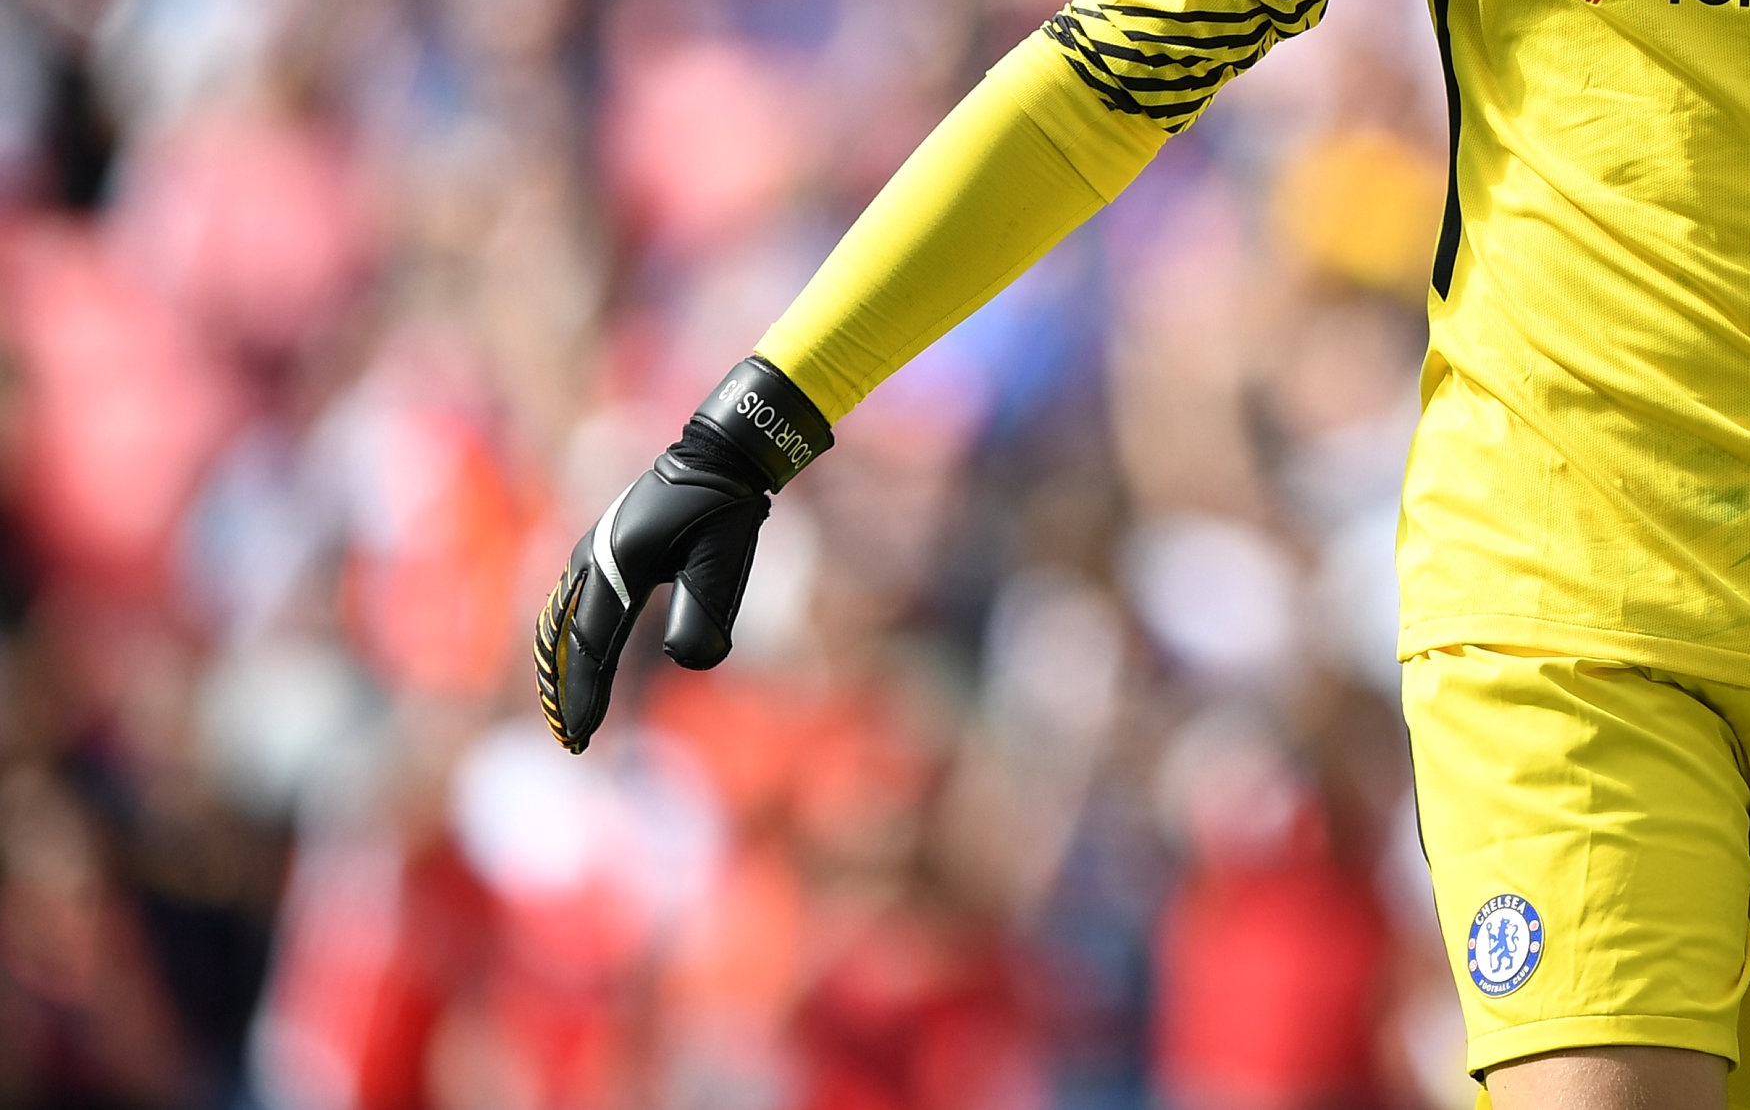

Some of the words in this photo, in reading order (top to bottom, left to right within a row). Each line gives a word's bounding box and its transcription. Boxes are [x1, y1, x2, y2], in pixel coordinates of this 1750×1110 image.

[736, 391, 813, 470] COURTOIS
[1475, 895, 1527, 926] CHELSEA
[1479, 979, 1511, 993] FOOTBALL
[1512, 965, 1530, 985] CLUB
